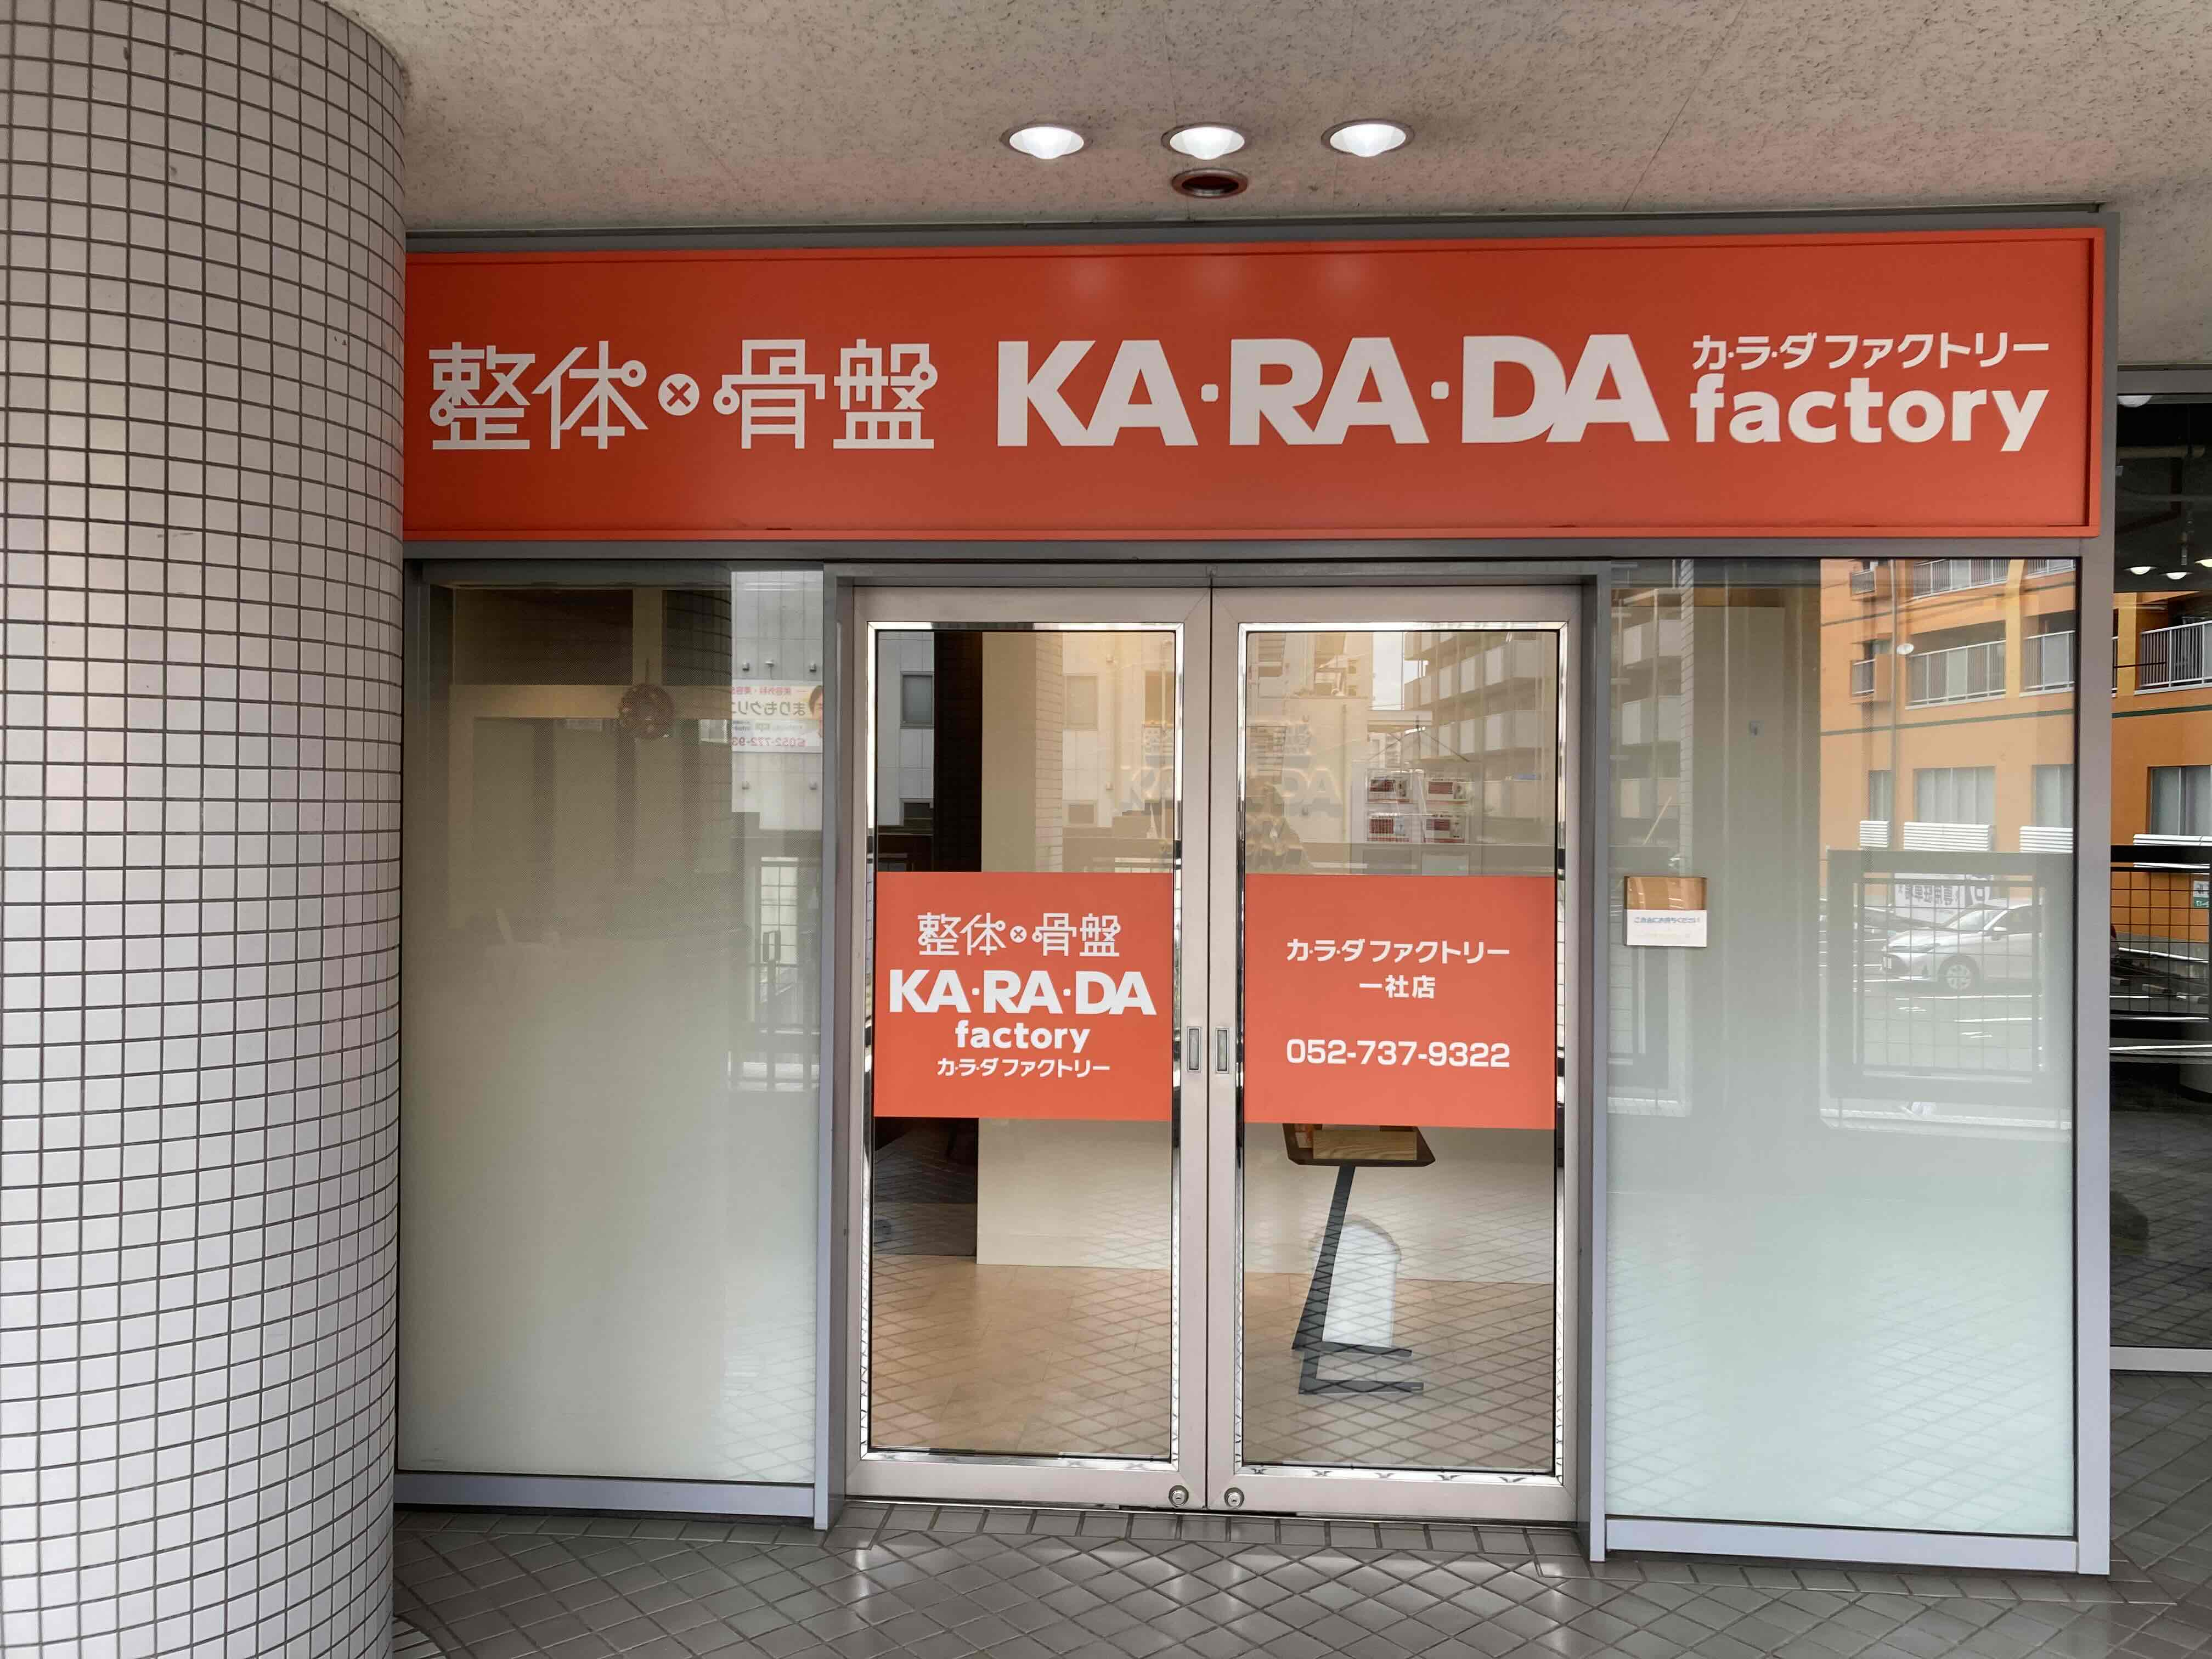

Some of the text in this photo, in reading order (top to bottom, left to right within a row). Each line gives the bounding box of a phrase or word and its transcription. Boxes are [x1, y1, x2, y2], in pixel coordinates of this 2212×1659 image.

[1689, 373, 2050, 452] factory
[1359, 975, 1436, 999] 一社店
[955, 1020, 1091, 1053] factory
[1286, 1039, 1510, 1068] 052-737-9322
